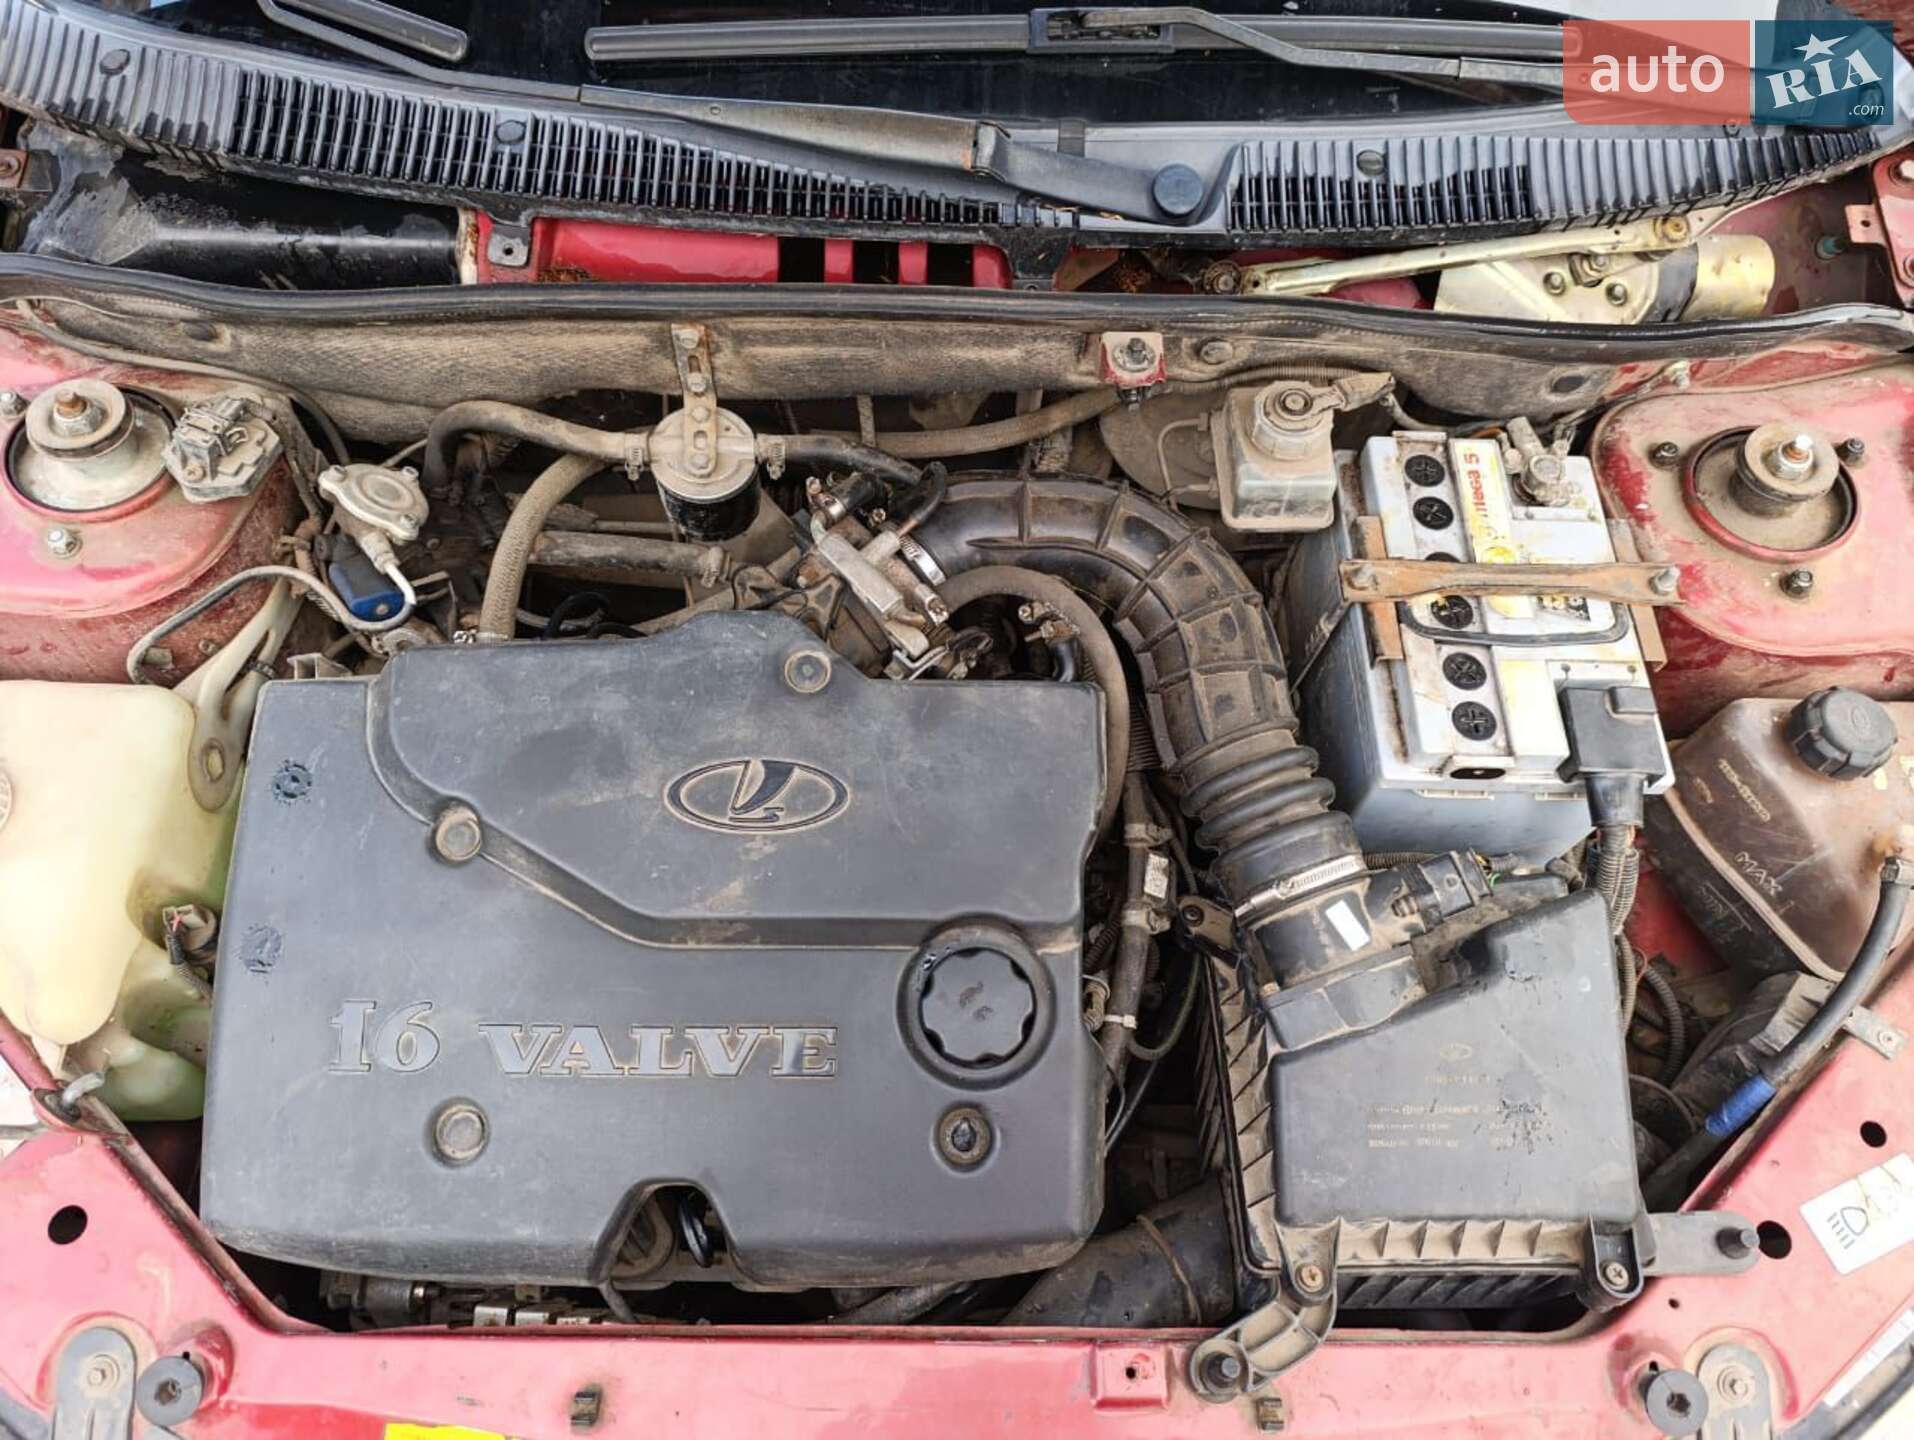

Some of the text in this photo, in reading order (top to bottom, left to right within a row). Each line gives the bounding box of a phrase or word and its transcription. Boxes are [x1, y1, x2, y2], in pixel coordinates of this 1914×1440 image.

[1735, 851, 1784, 897] MAX
[328, 1000, 839, 1077] 16 VALVE
